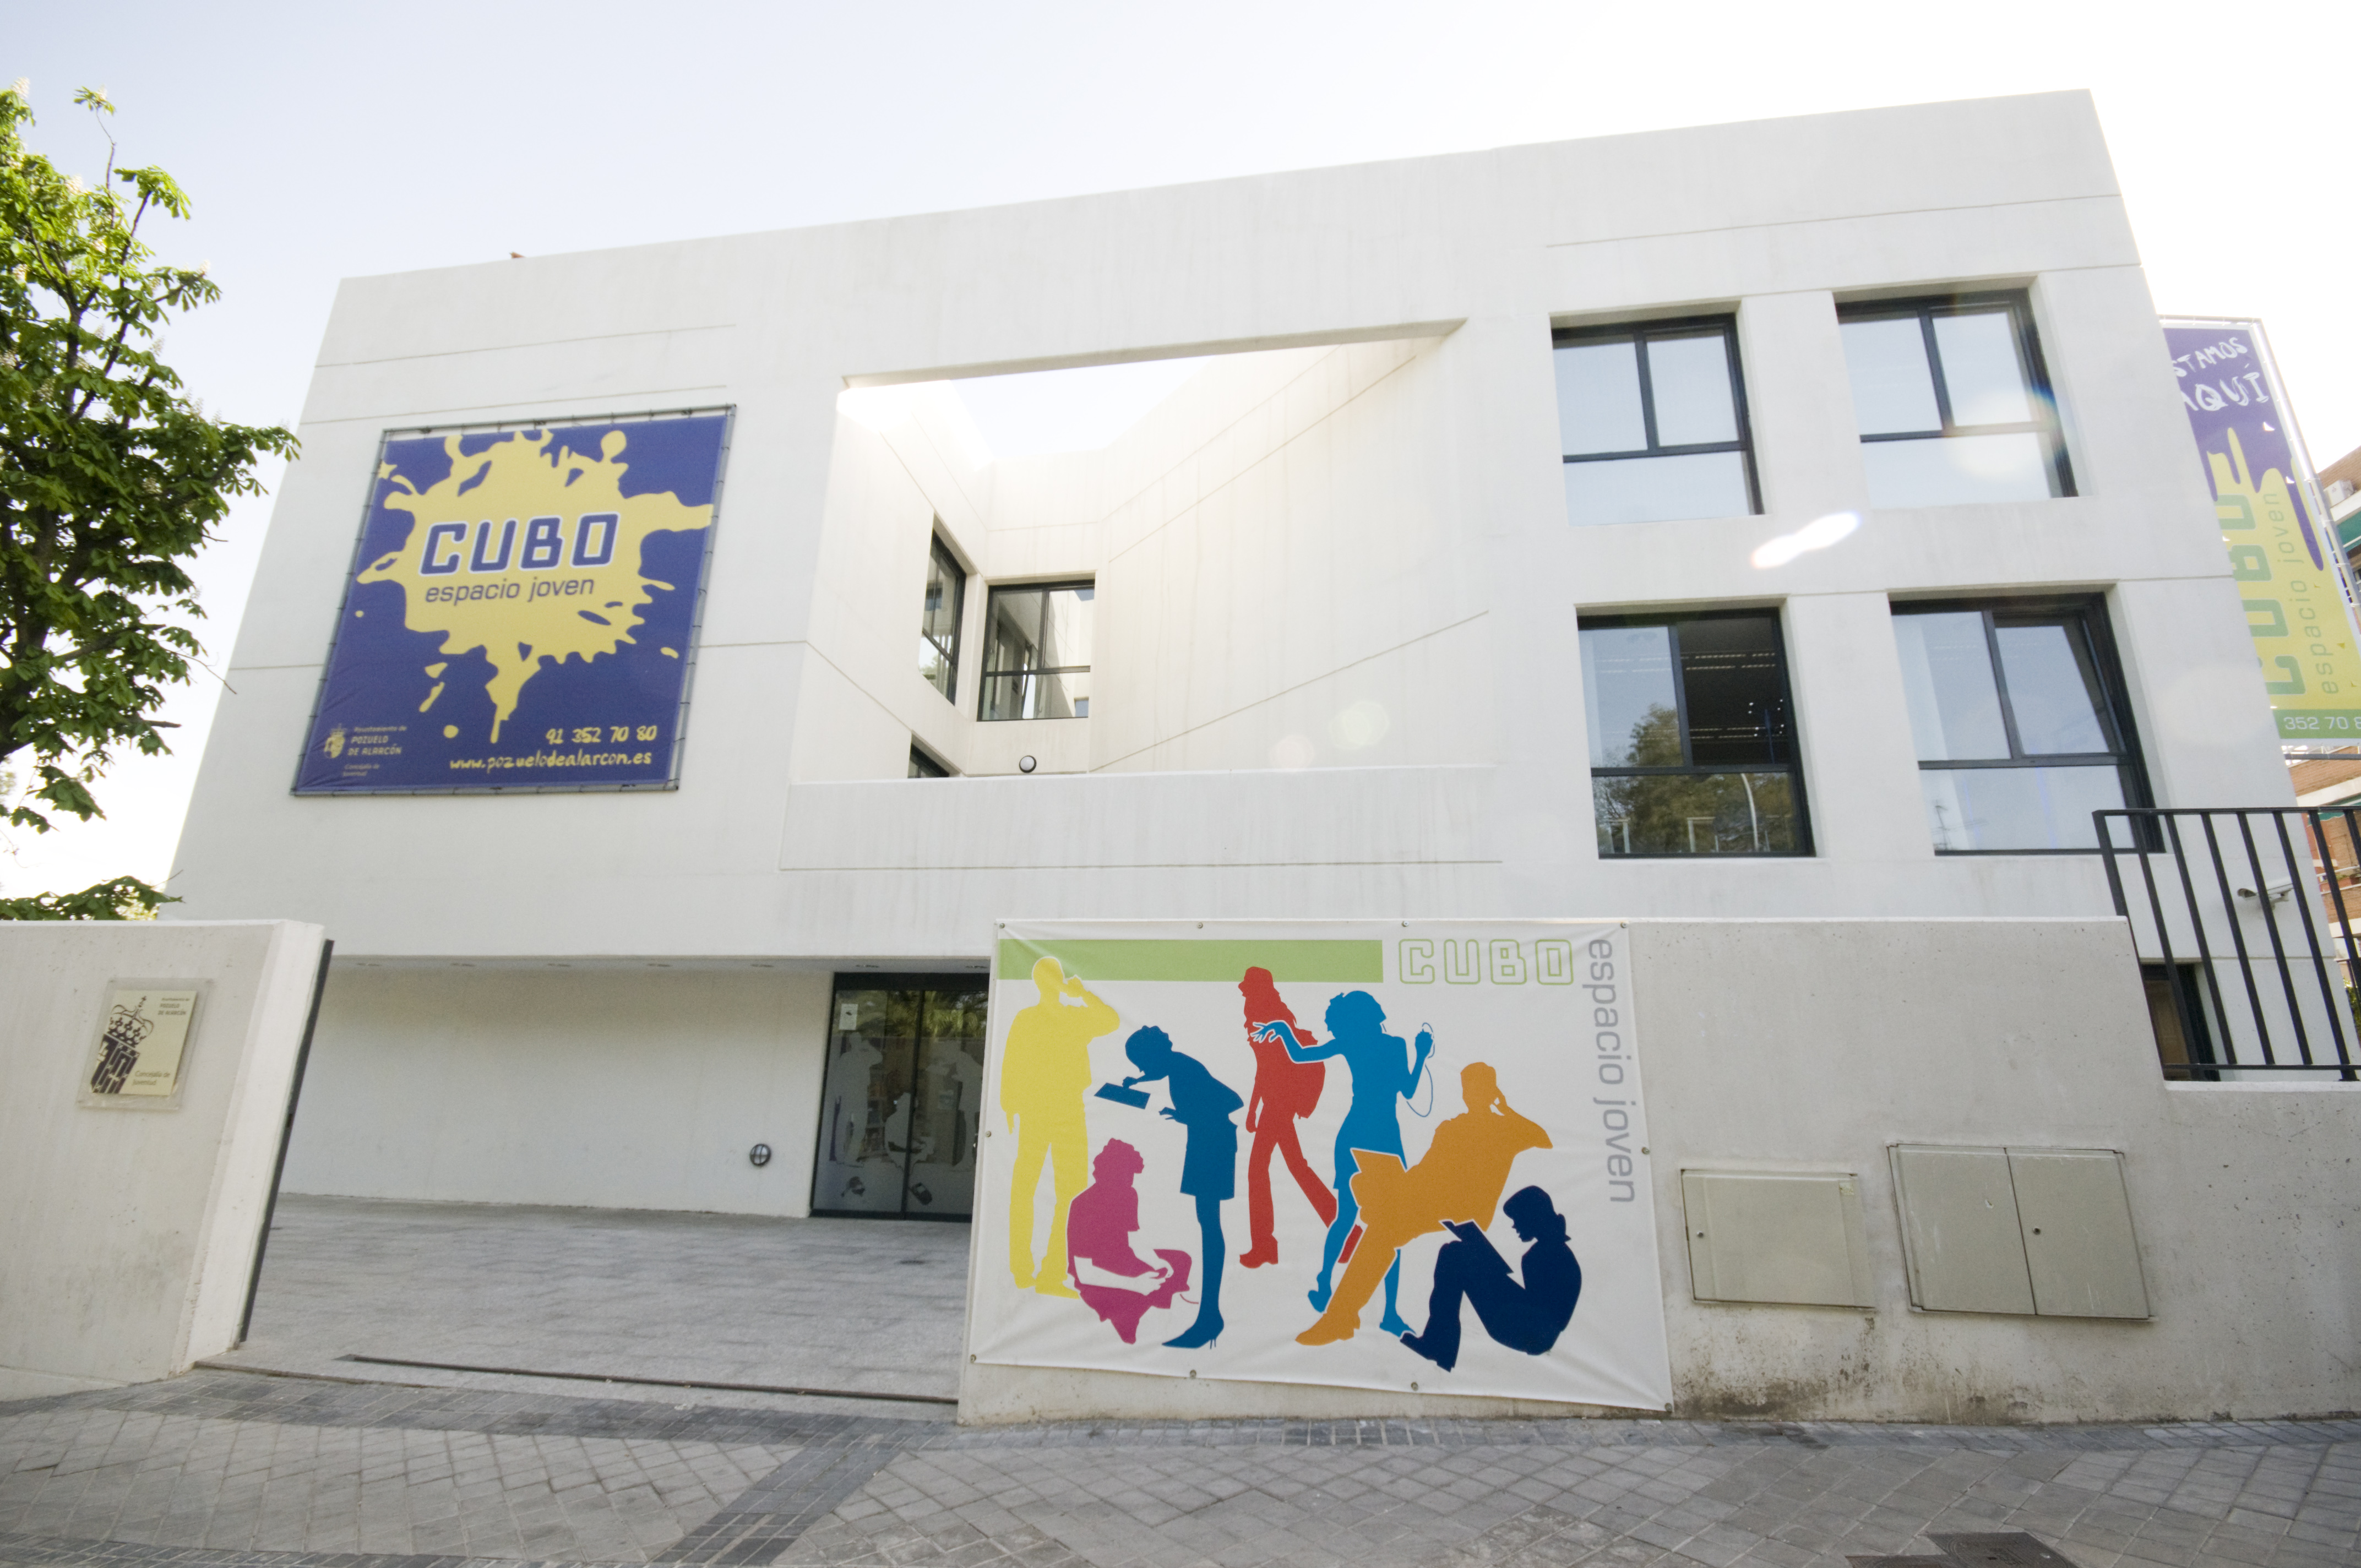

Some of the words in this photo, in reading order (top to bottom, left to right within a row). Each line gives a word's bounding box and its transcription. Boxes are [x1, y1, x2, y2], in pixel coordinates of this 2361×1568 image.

[418, 511, 621, 576] CUBO
[2264, 493, 2305, 564] joven
[425, 578, 520, 606] espacio
[527, 577, 594, 602] joven
[2289, 580, 2339, 695] espacio
[546, 728, 564, 744] 91
[572, 727, 601, 743] 352
[610, 726, 629, 743] 70
[637, 725, 657, 741] 80
[2283, 717, 2320, 729] 352
[2325, 717, 2349, 729] 70
[450, 749, 652, 774] www.pozuelodealarcon.es
[1399, 939, 1574, 986] CUBO
[1582, 939, 1631, 1085] espacio
[1593, 1097, 1636, 1203] joven
